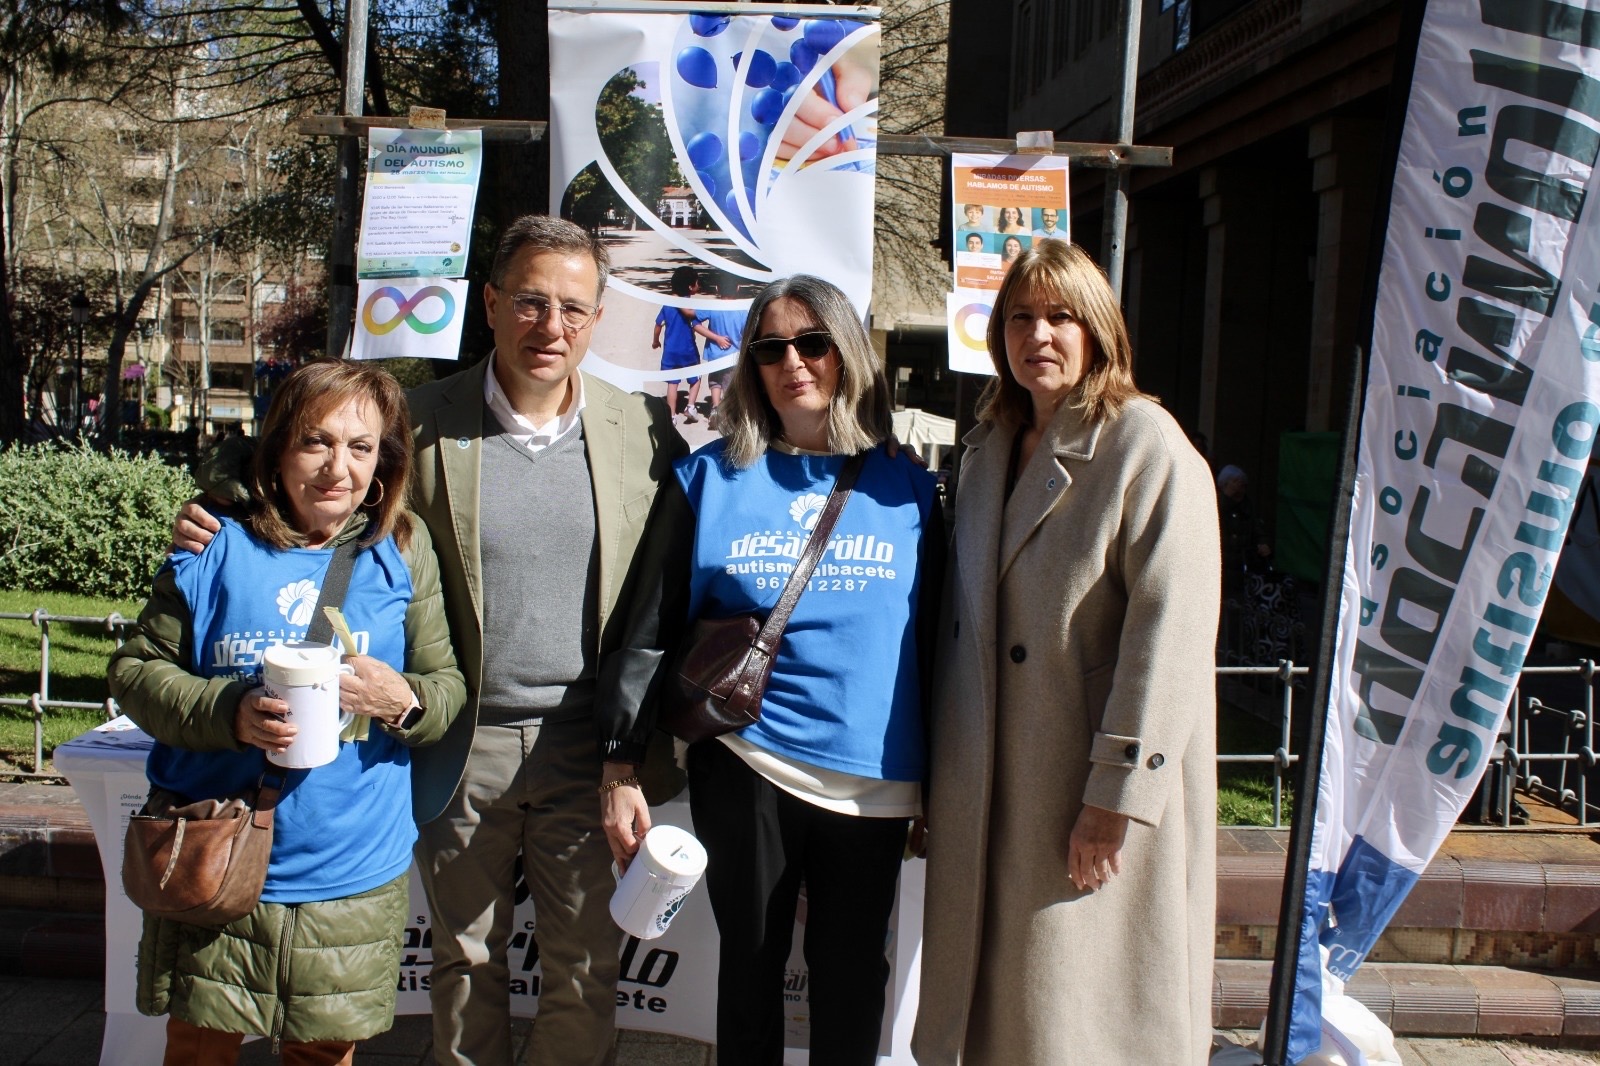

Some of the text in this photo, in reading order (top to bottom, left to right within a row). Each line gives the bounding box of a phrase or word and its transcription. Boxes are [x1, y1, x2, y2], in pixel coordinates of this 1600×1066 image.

[386, 143, 465, 155] DÍA MUNDIAL
[384, 159, 465, 168] DEL AUTISMO
[973, 173, 1047, 183] MIRADAS DIVERSAS:
[967, 181, 1008, 190] HABLAMOS
[725, 533, 894, 563] desarollo
[812, 564, 896, 580] albacete
[756, 576, 868, 592] 96712287
